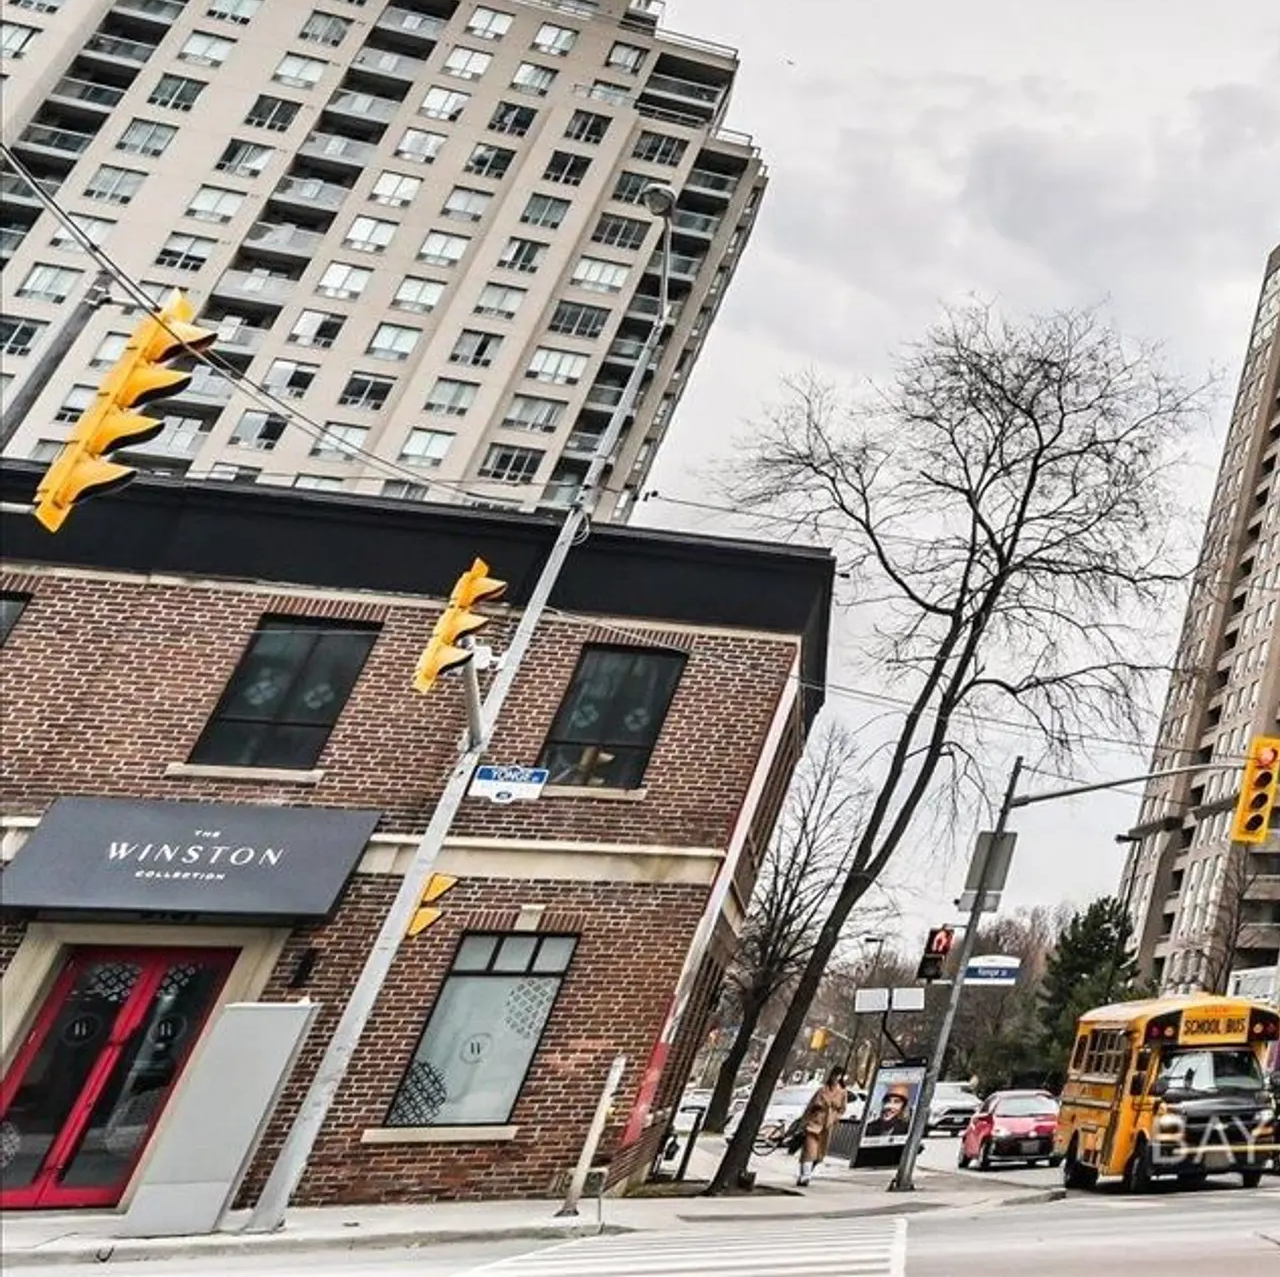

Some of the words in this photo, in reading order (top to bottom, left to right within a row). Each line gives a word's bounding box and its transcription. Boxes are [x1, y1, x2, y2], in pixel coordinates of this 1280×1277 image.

[194, 829, 222, 839] THE
[108, 841, 285, 866] WINSTON
[135, 870, 226, 881] COLLECTION
[1184, 1019, 1220, 1035] SCHOOL
[1226, 1018, 1246, 1034] BUS
